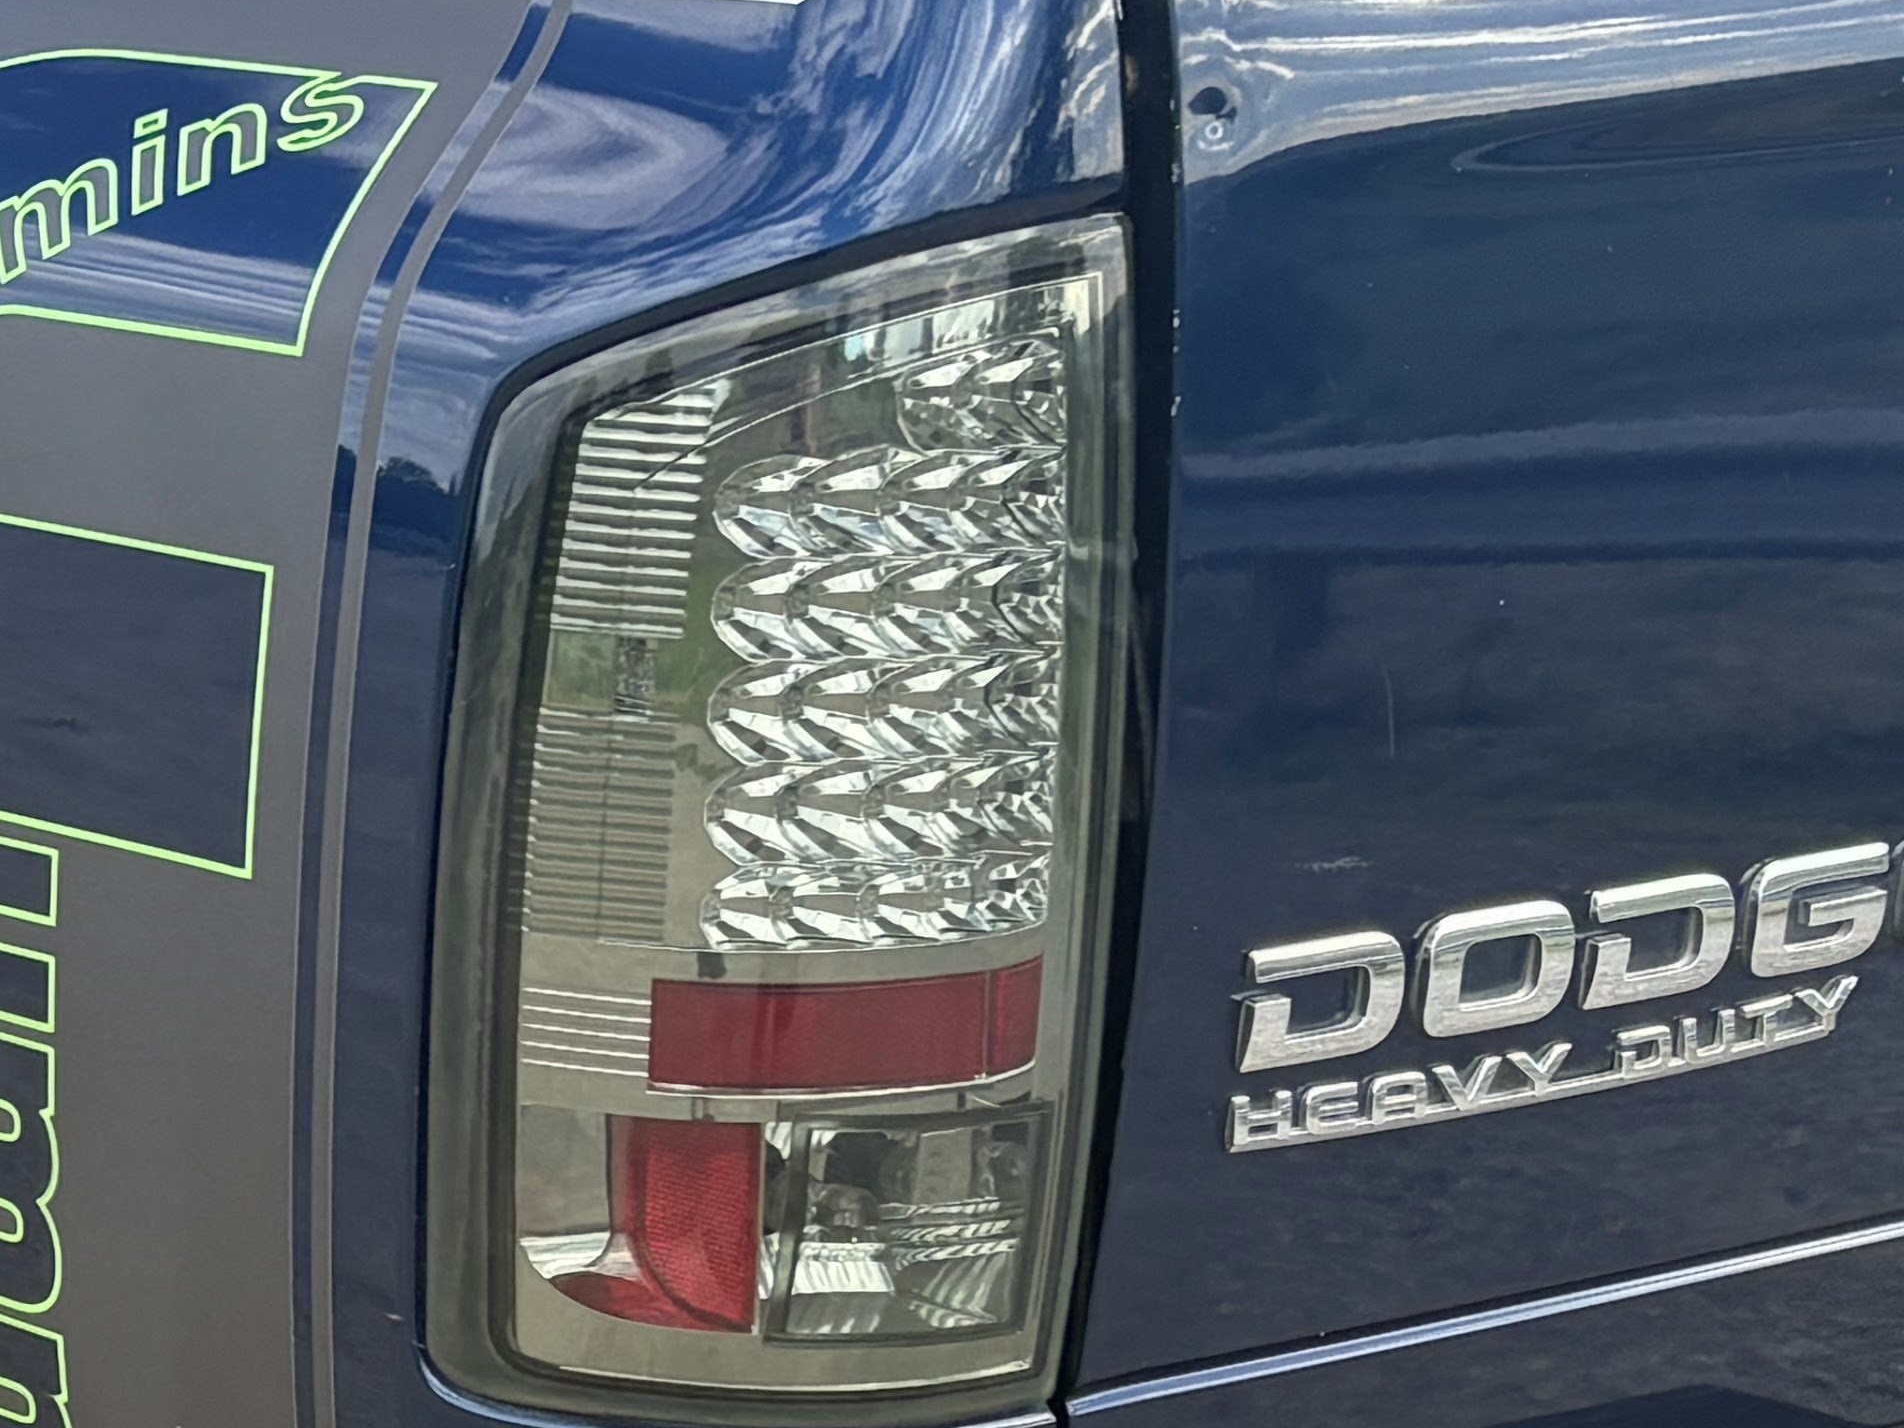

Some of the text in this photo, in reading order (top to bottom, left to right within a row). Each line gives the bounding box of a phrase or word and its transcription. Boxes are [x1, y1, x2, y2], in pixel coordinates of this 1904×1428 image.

[1236, 839, 1904, 1074] DODG
[1227, 974, 1859, 1153] HEAVY DUTY
